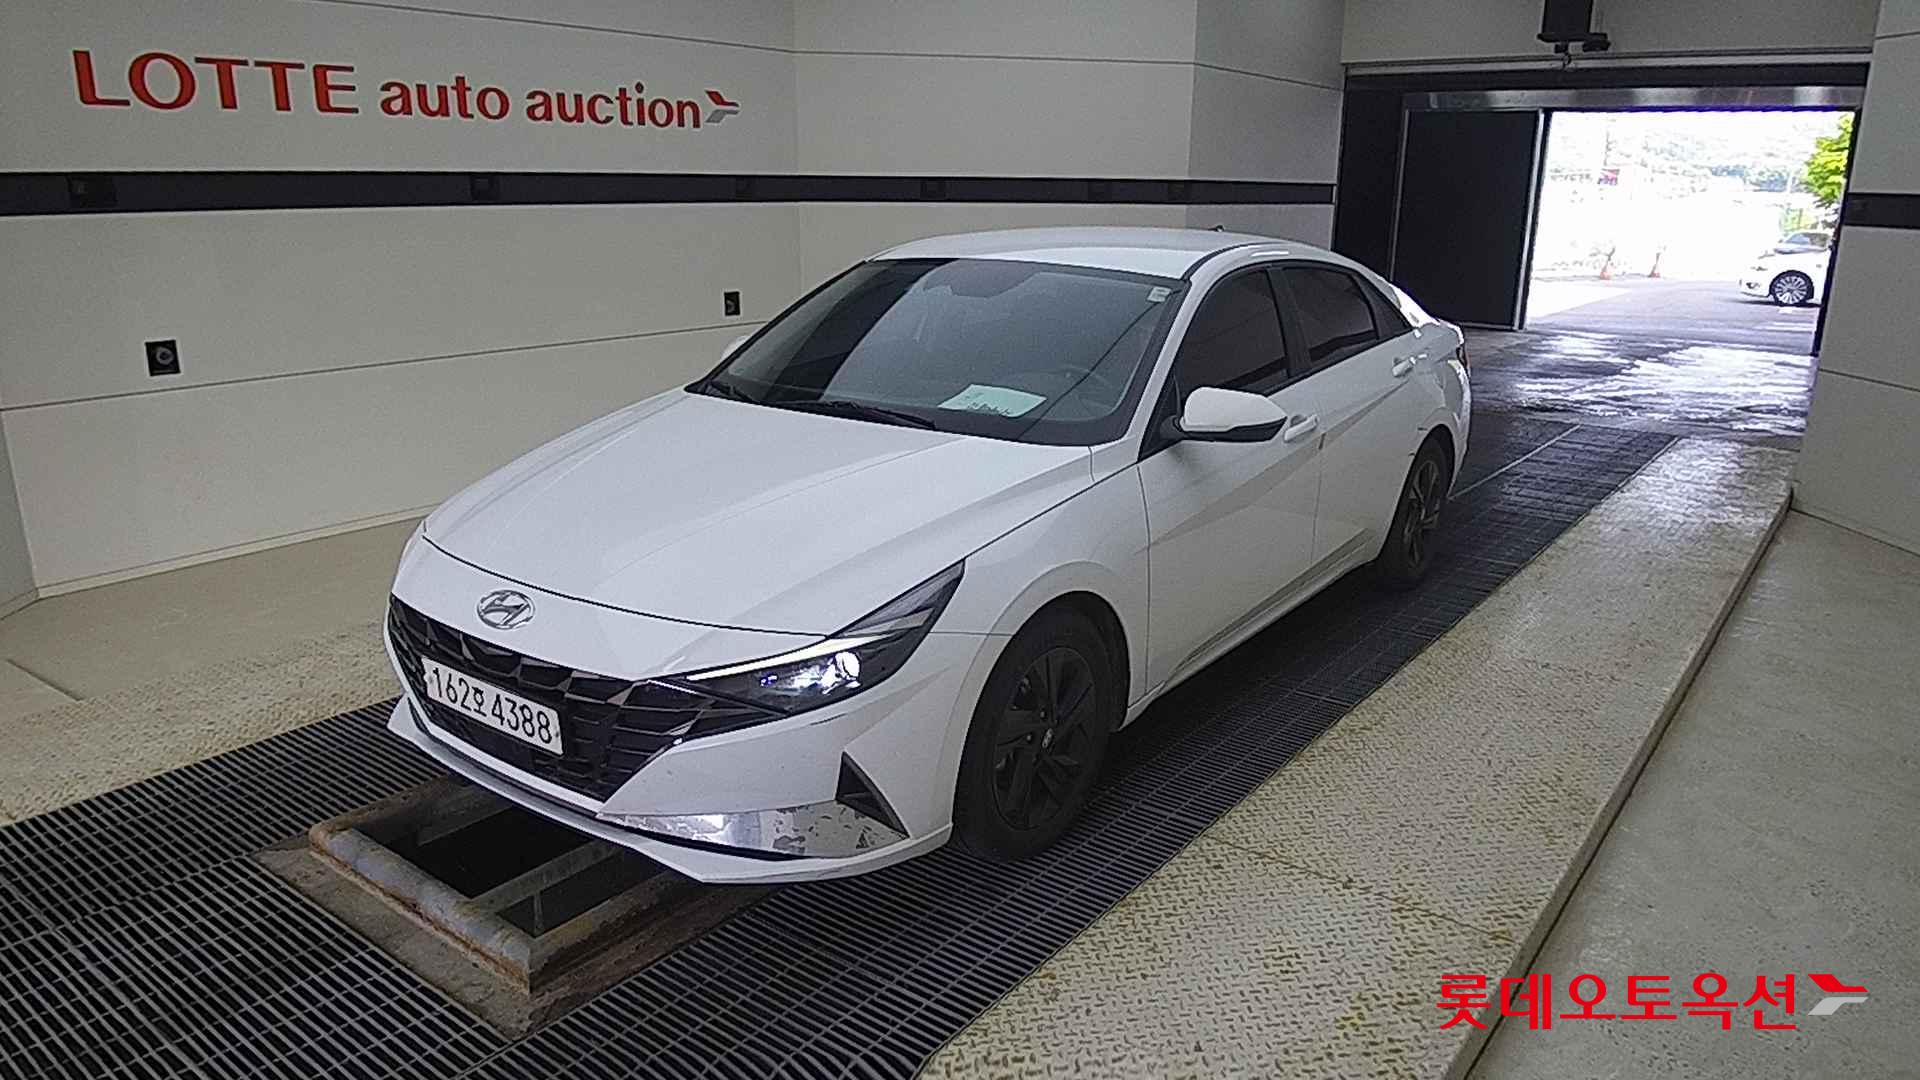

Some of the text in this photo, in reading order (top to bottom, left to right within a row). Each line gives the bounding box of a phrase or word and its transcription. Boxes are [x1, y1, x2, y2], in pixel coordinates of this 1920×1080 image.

[73, 50, 700, 127] LOTTE auto auction
